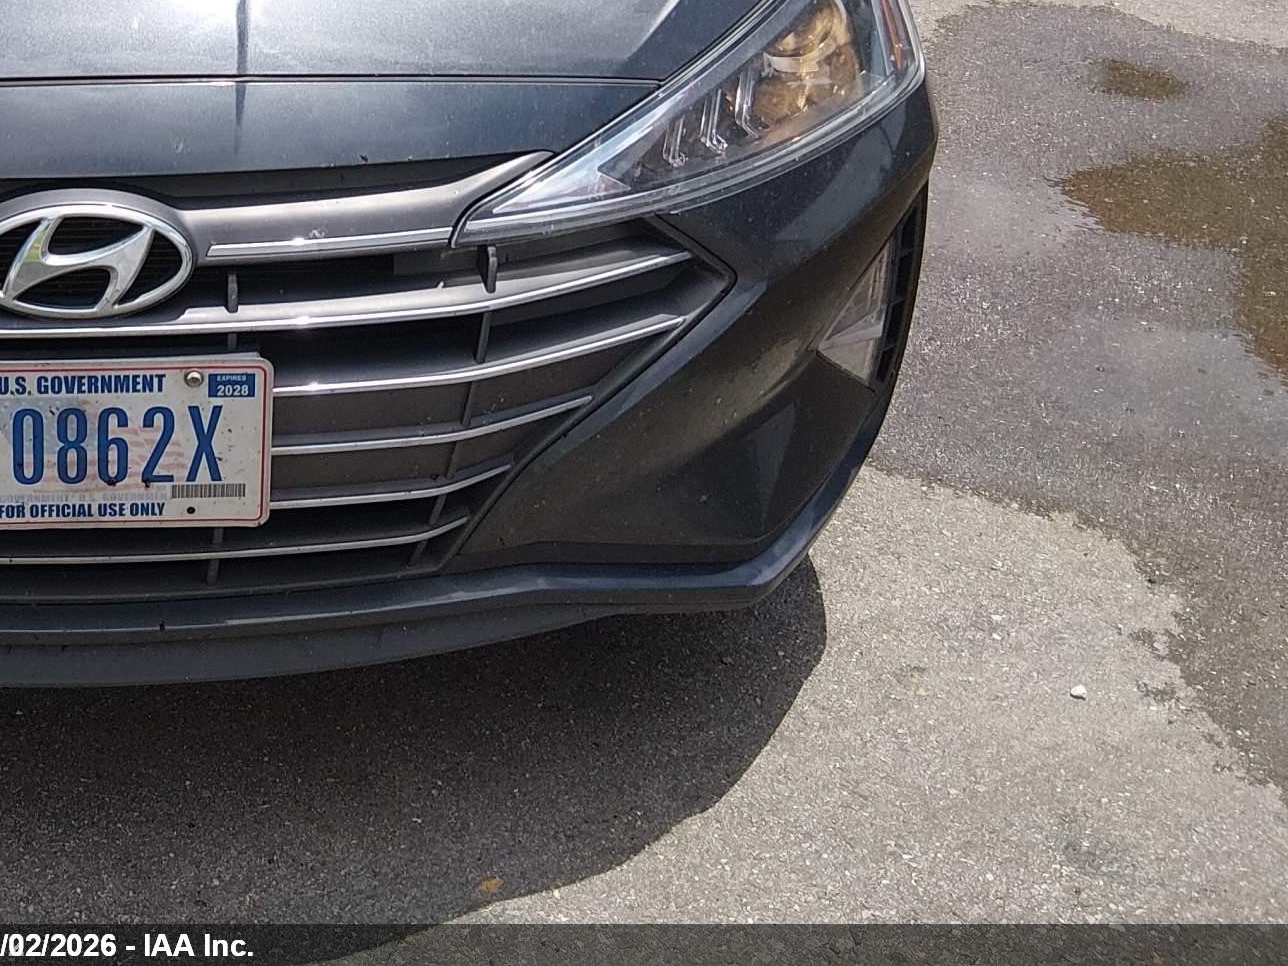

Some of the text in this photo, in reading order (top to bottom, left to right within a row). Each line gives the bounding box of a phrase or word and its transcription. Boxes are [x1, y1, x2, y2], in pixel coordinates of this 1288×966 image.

[37, 374, 166, 395] GOVERNMENT
[216, 374, 247, 382] EXPIRES
[217, 384, 249, 396] 2028
[13, 405, 223, 485] 0862X
[30, 503, 93, 518] OFFICIAL
[98, 502, 125, 517] USE
[130, 502, 165, 517] ONLY
